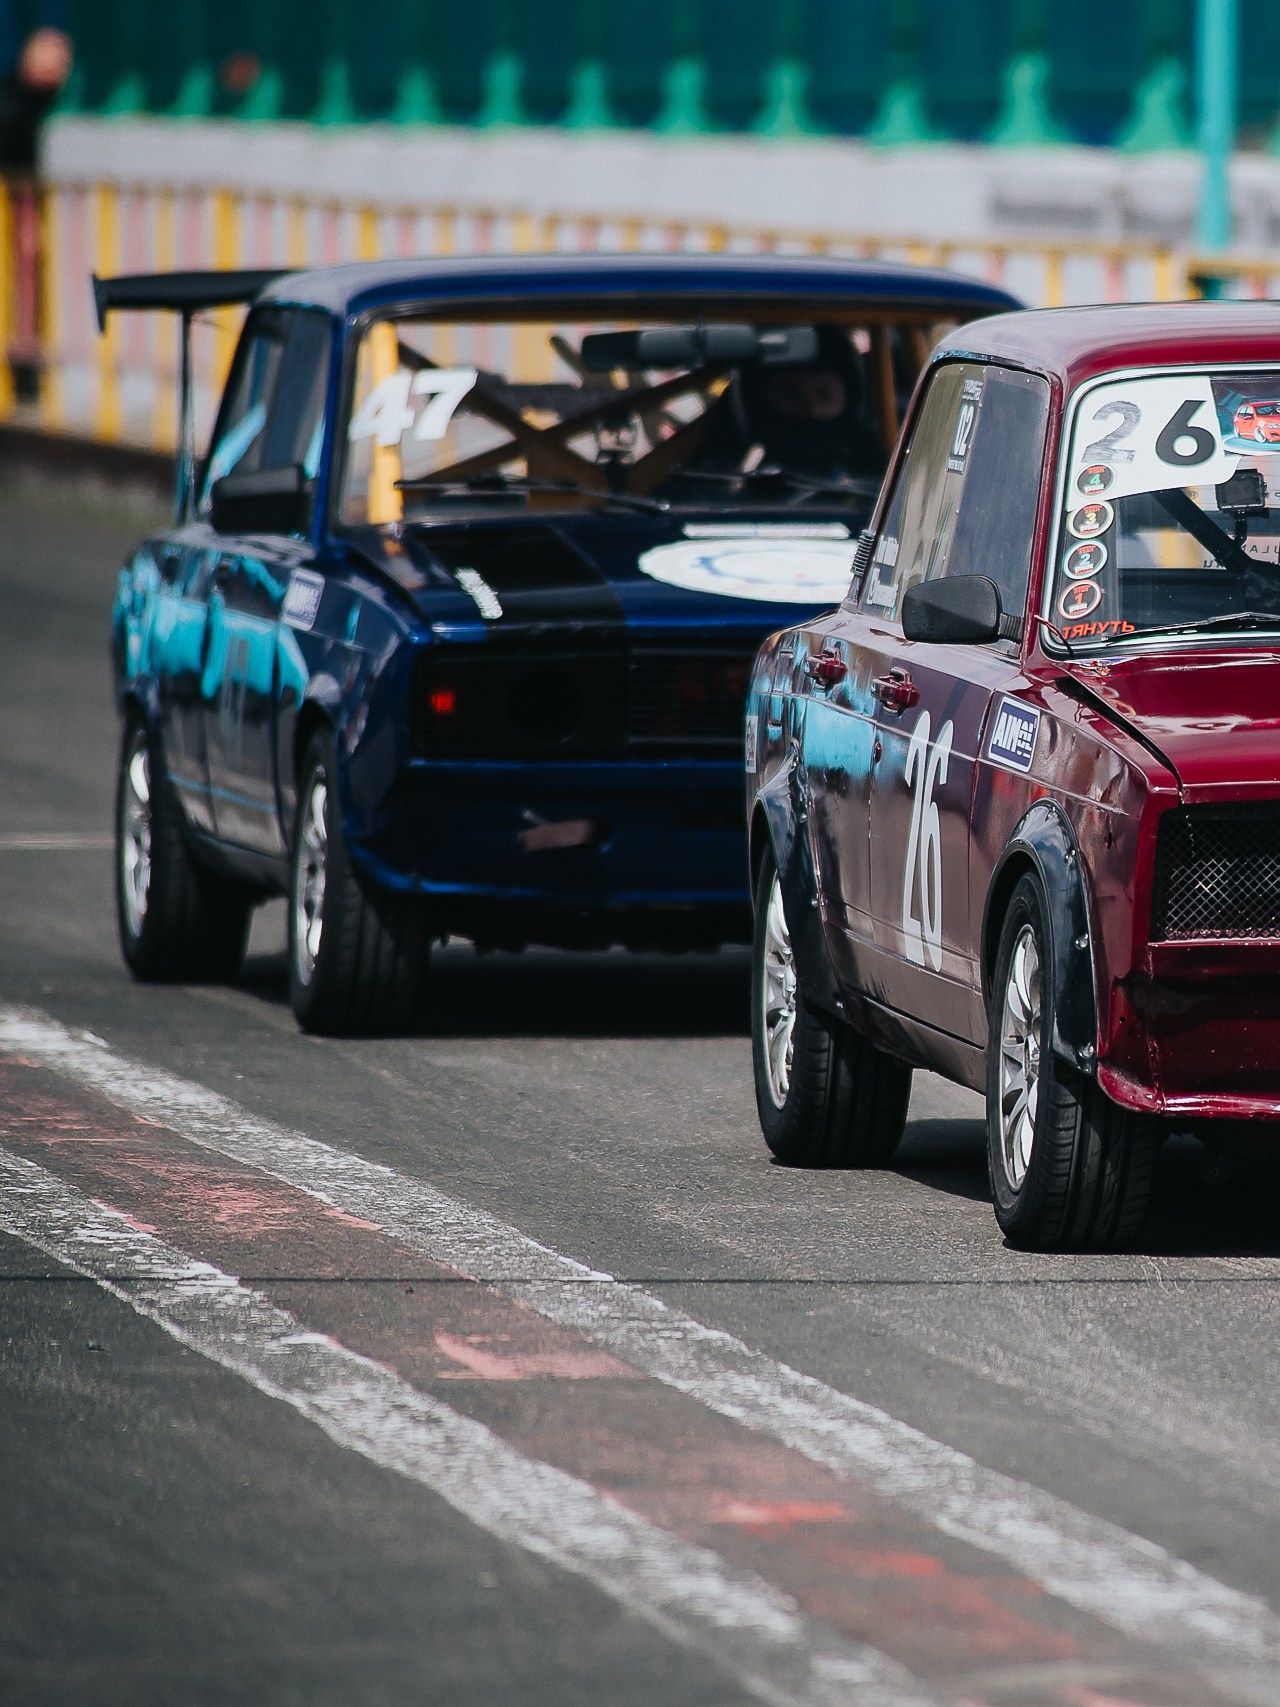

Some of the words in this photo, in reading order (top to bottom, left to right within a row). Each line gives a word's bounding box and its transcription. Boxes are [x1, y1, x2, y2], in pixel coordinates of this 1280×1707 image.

[348, 368, 478, 446] 47
[1081, 400, 1217, 466] 26
[1089, 473, 1101, 486] 4
[1085, 512, 1097, 525] 3
[1080, 553, 1091, 566] 2
[1075, 592, 1084, 604] 1
[1062, 620, 1136, 640] ТЯНУТЬ
[904, 710, 954, 973] 26
